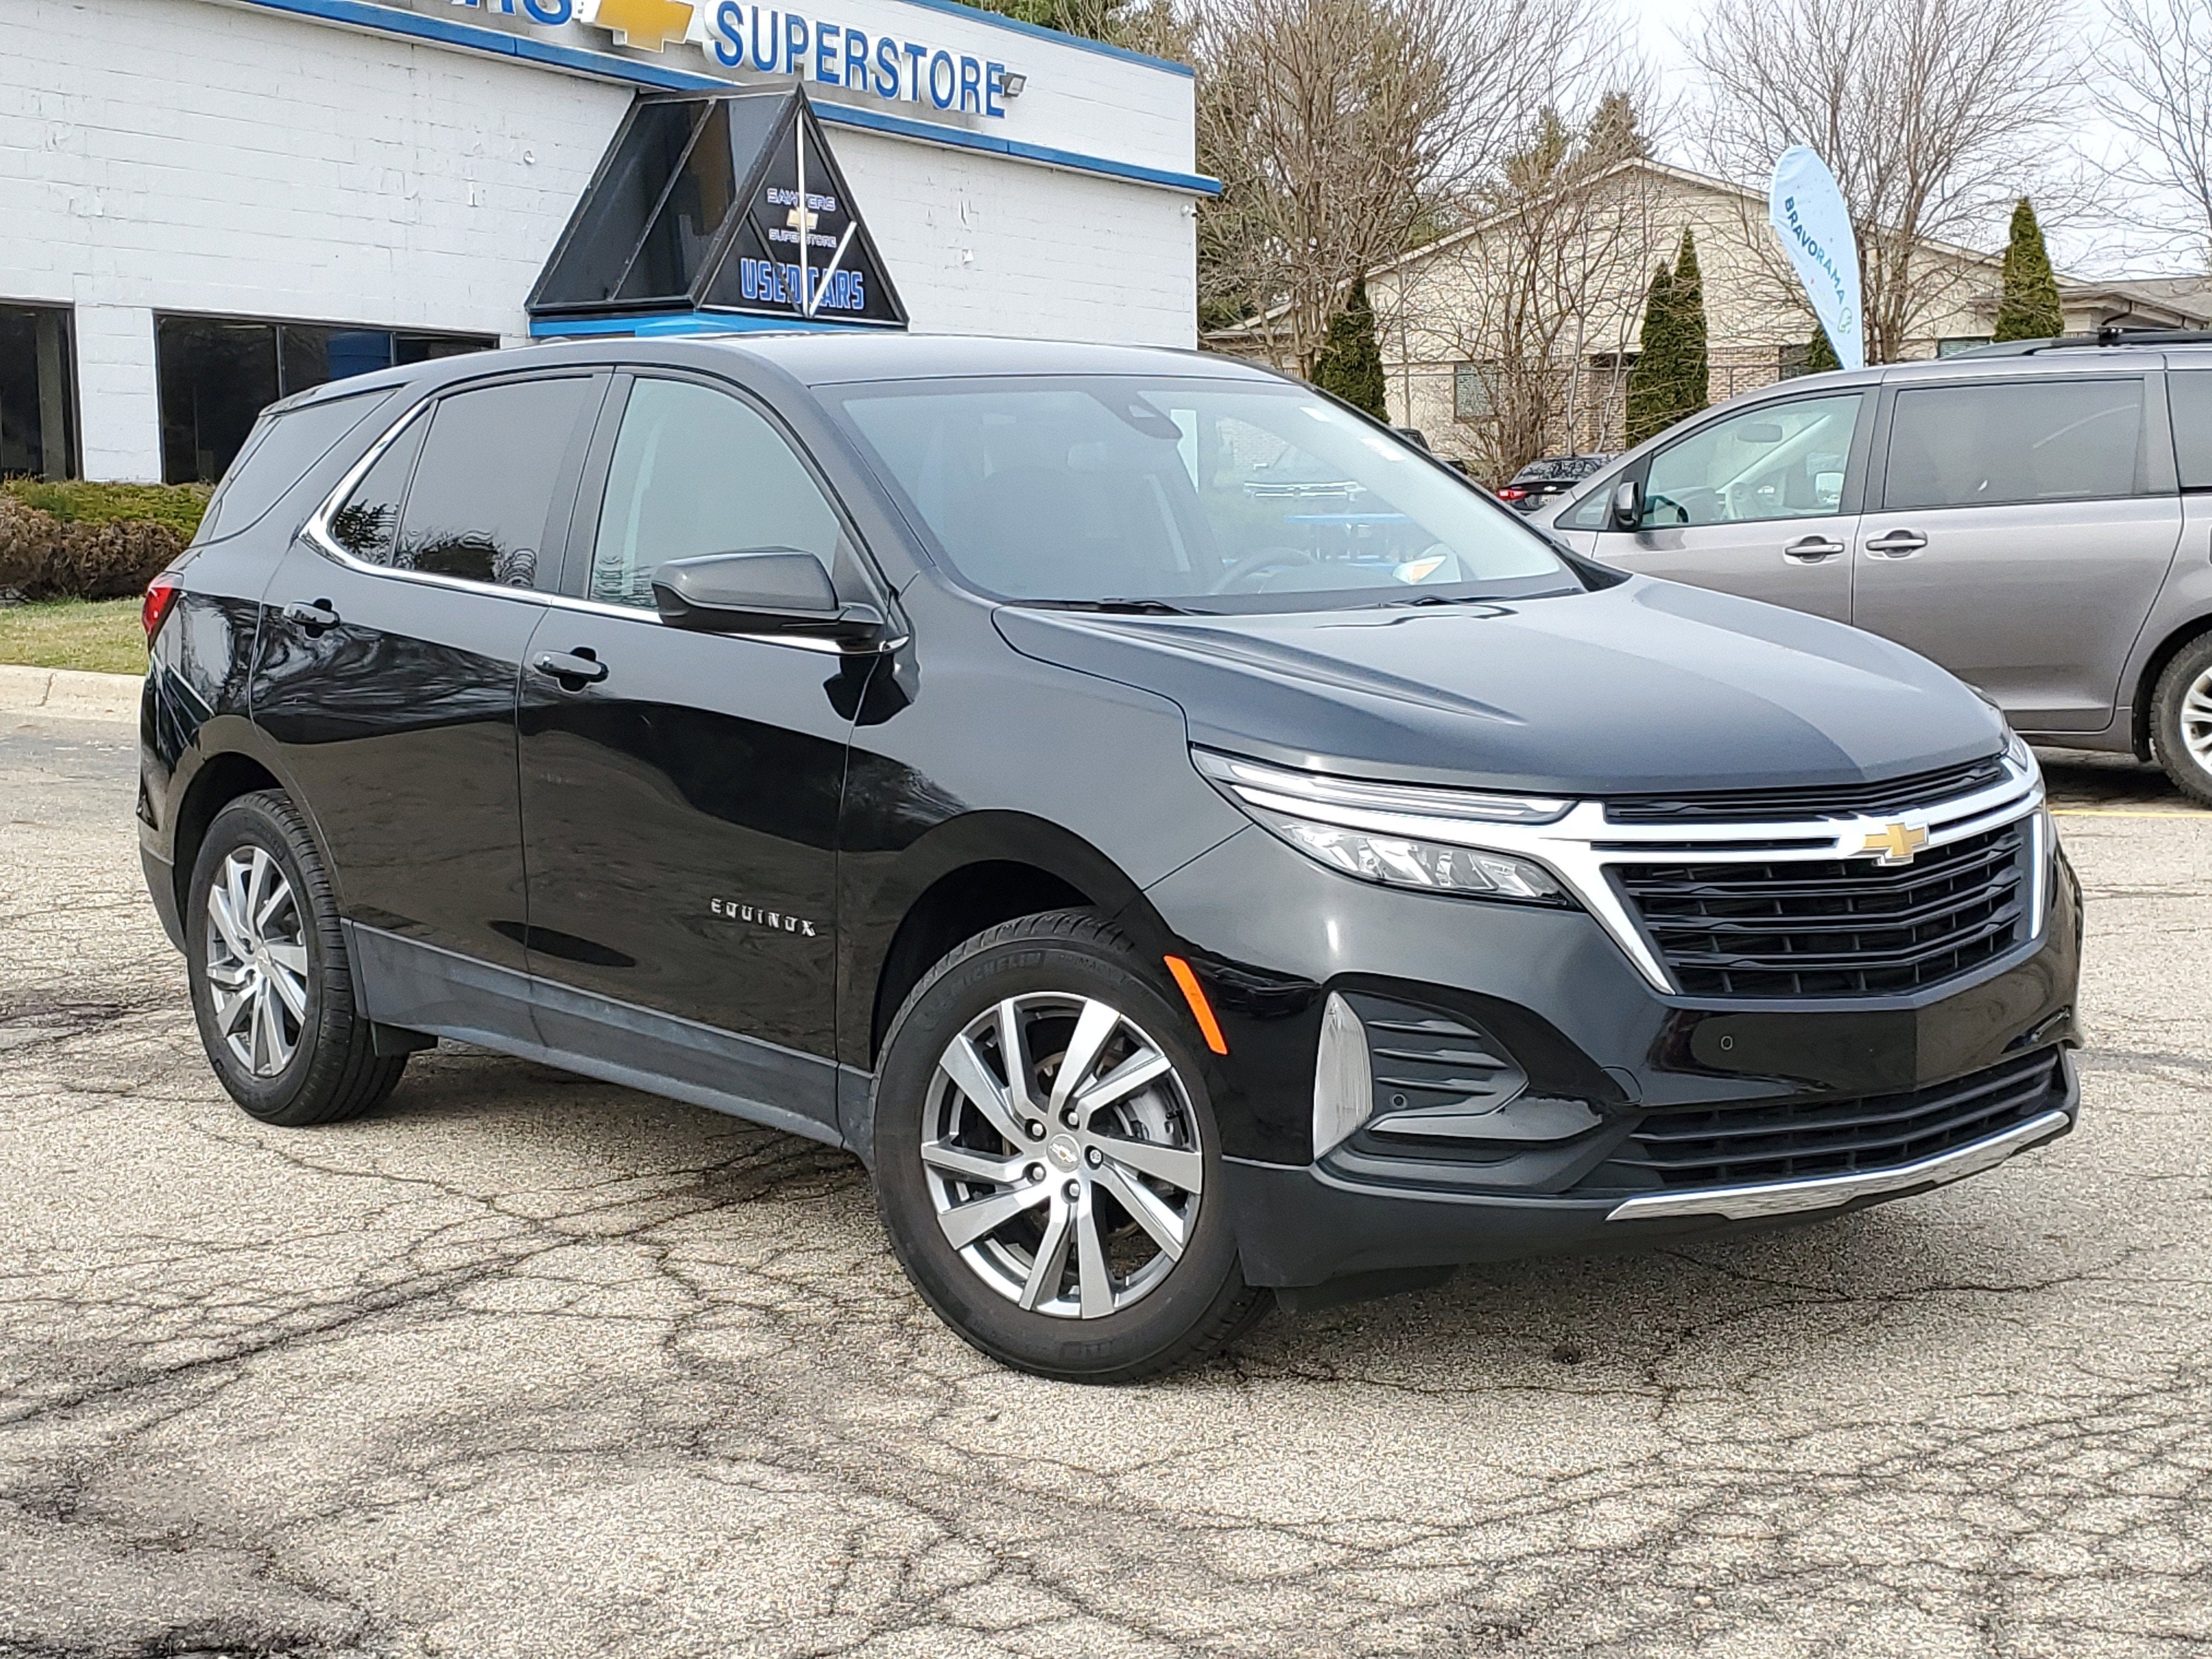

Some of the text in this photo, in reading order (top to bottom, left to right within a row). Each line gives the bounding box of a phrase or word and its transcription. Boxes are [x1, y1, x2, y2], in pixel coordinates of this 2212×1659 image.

[714, 1, 1006, 119] SUPERSTORE
[769, 228, 837, 249] SUPETORE
[1785, 196, 1846, 304] BRAVORAMA
[741, 258, 803, 304] USED
[710, 898, 816, 936] EQUINOX
